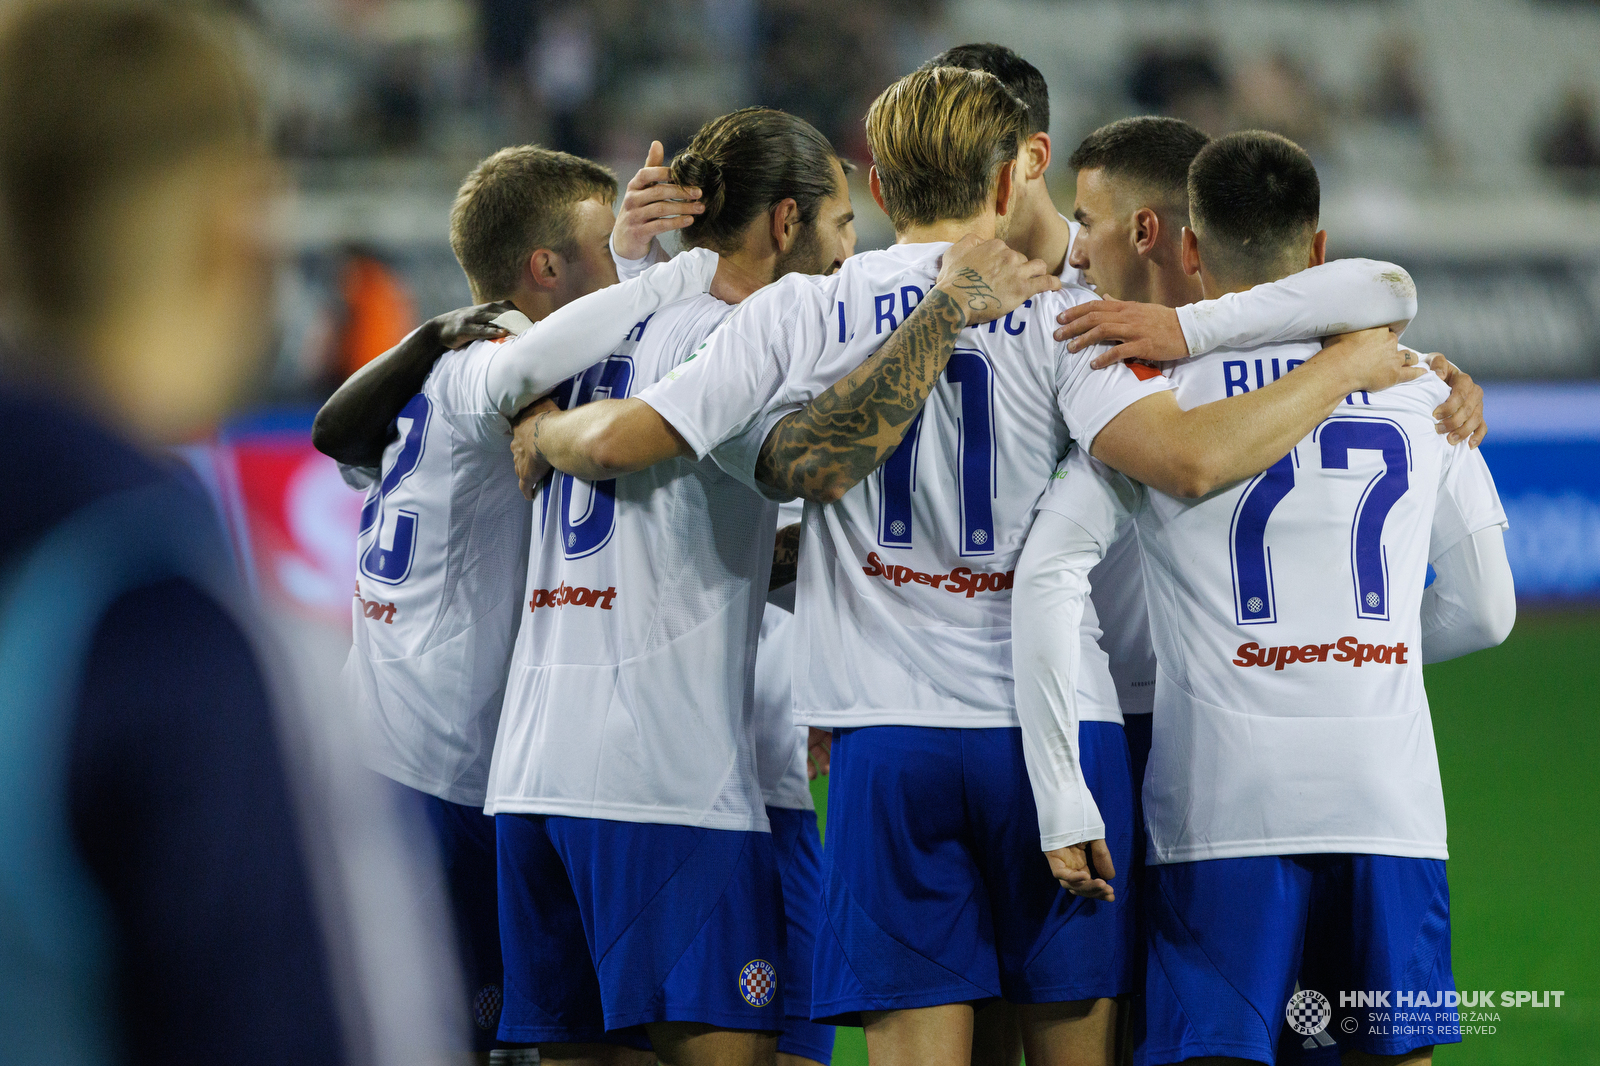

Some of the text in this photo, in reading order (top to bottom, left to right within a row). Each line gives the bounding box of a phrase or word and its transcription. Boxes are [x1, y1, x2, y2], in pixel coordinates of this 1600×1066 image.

[1229, 415, 1412, 626] 77
[1232, 636, 1408, 671] SuperSport
[744, 962, 774, 977] HAJDUK
[746, 993, 769, 1006] SPLIT
